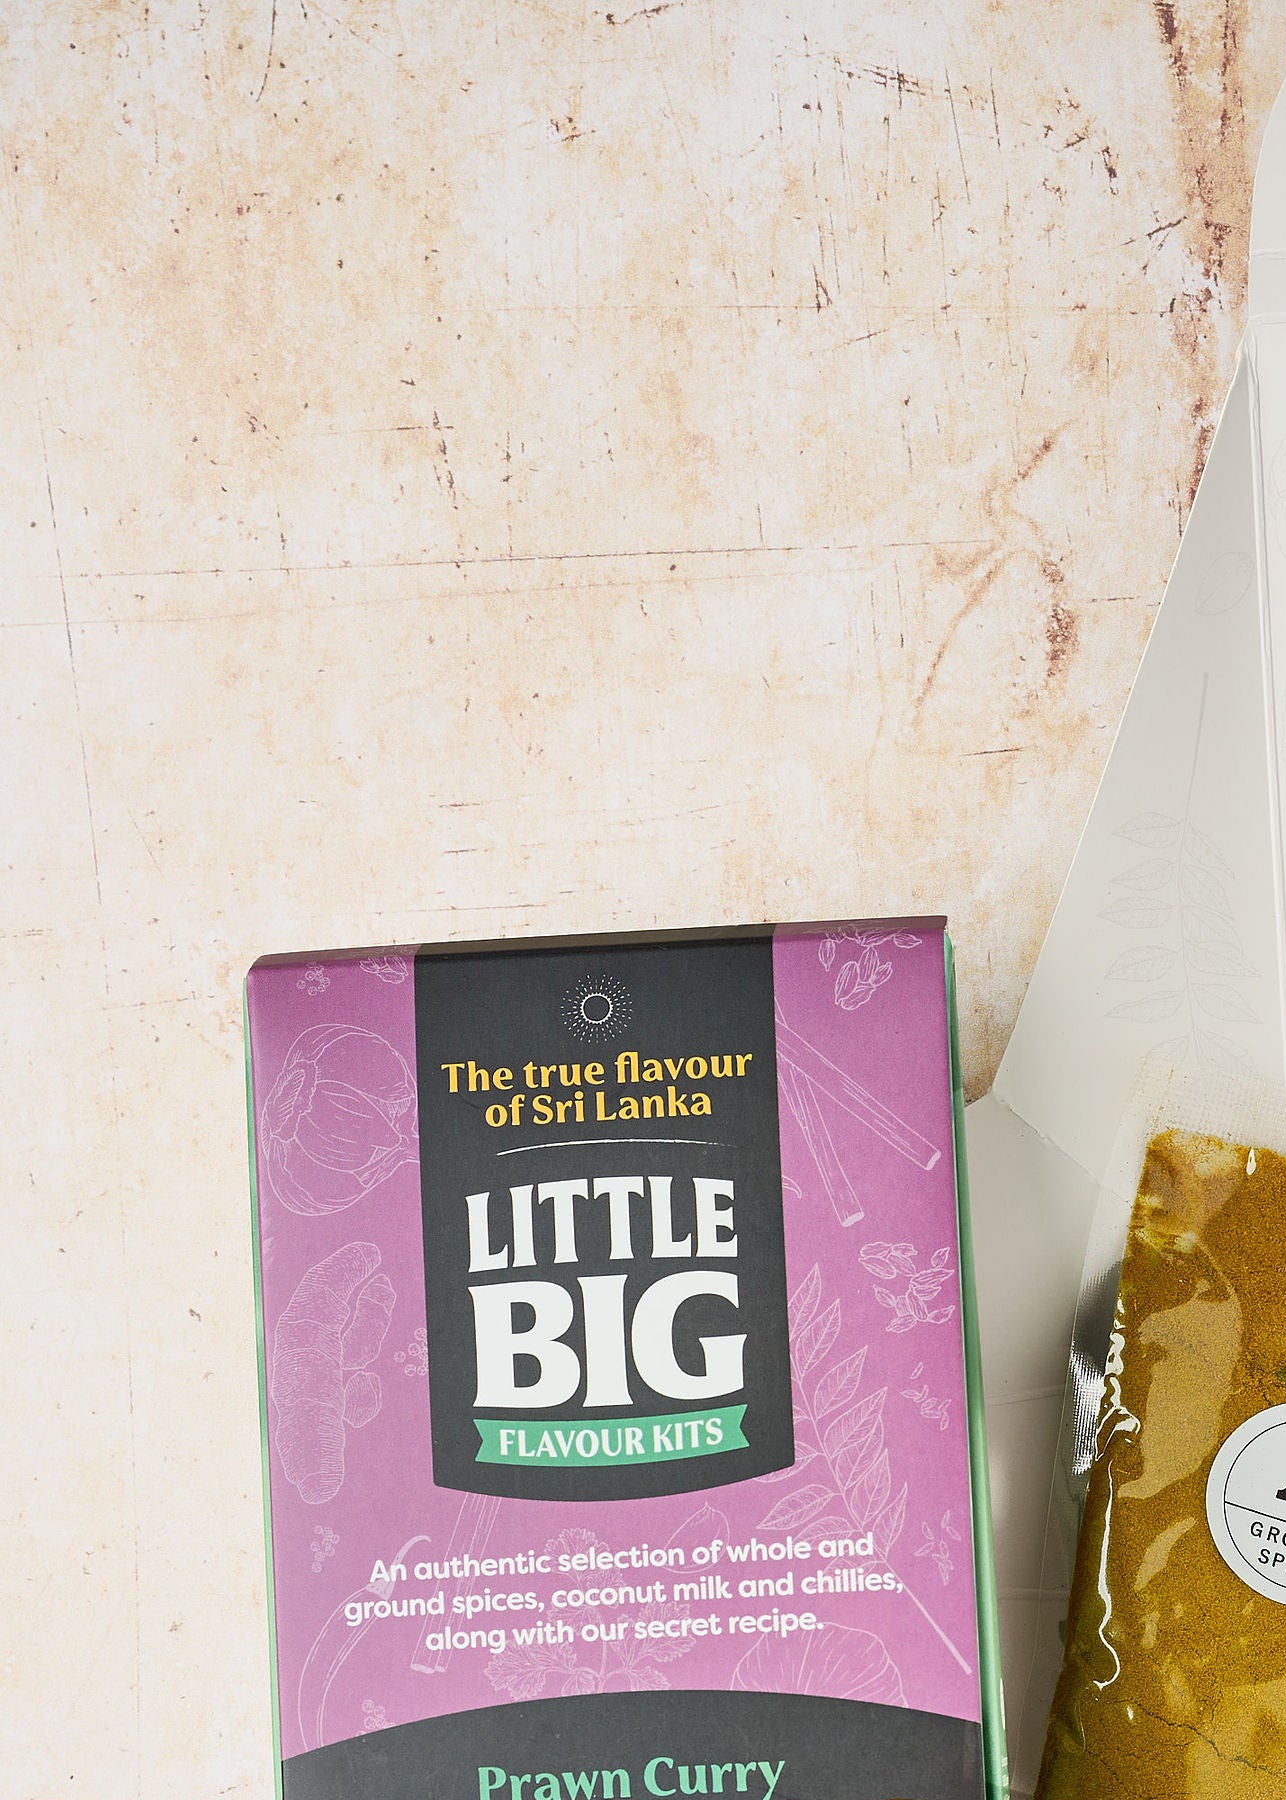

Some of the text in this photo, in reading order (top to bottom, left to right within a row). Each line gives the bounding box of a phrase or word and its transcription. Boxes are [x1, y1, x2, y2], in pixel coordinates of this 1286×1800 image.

[440, 1051, 753, 1093] The true flavour
[485, 1085, 712, 1128] of Sri Lanka
[465, 1175, 738, 1273] LITTLE
[467, 1270, 748, 1409] BIG
[499, 1417, 723, 1458] FLAVOUR KITS
[369, 1531, 875, 1583] An authentic selection of whole and
[344, 1566, 904, 1627] ground spices, coconut milk and chillies,
[425, 1607, 825, 1655] along with our secret recipe.
